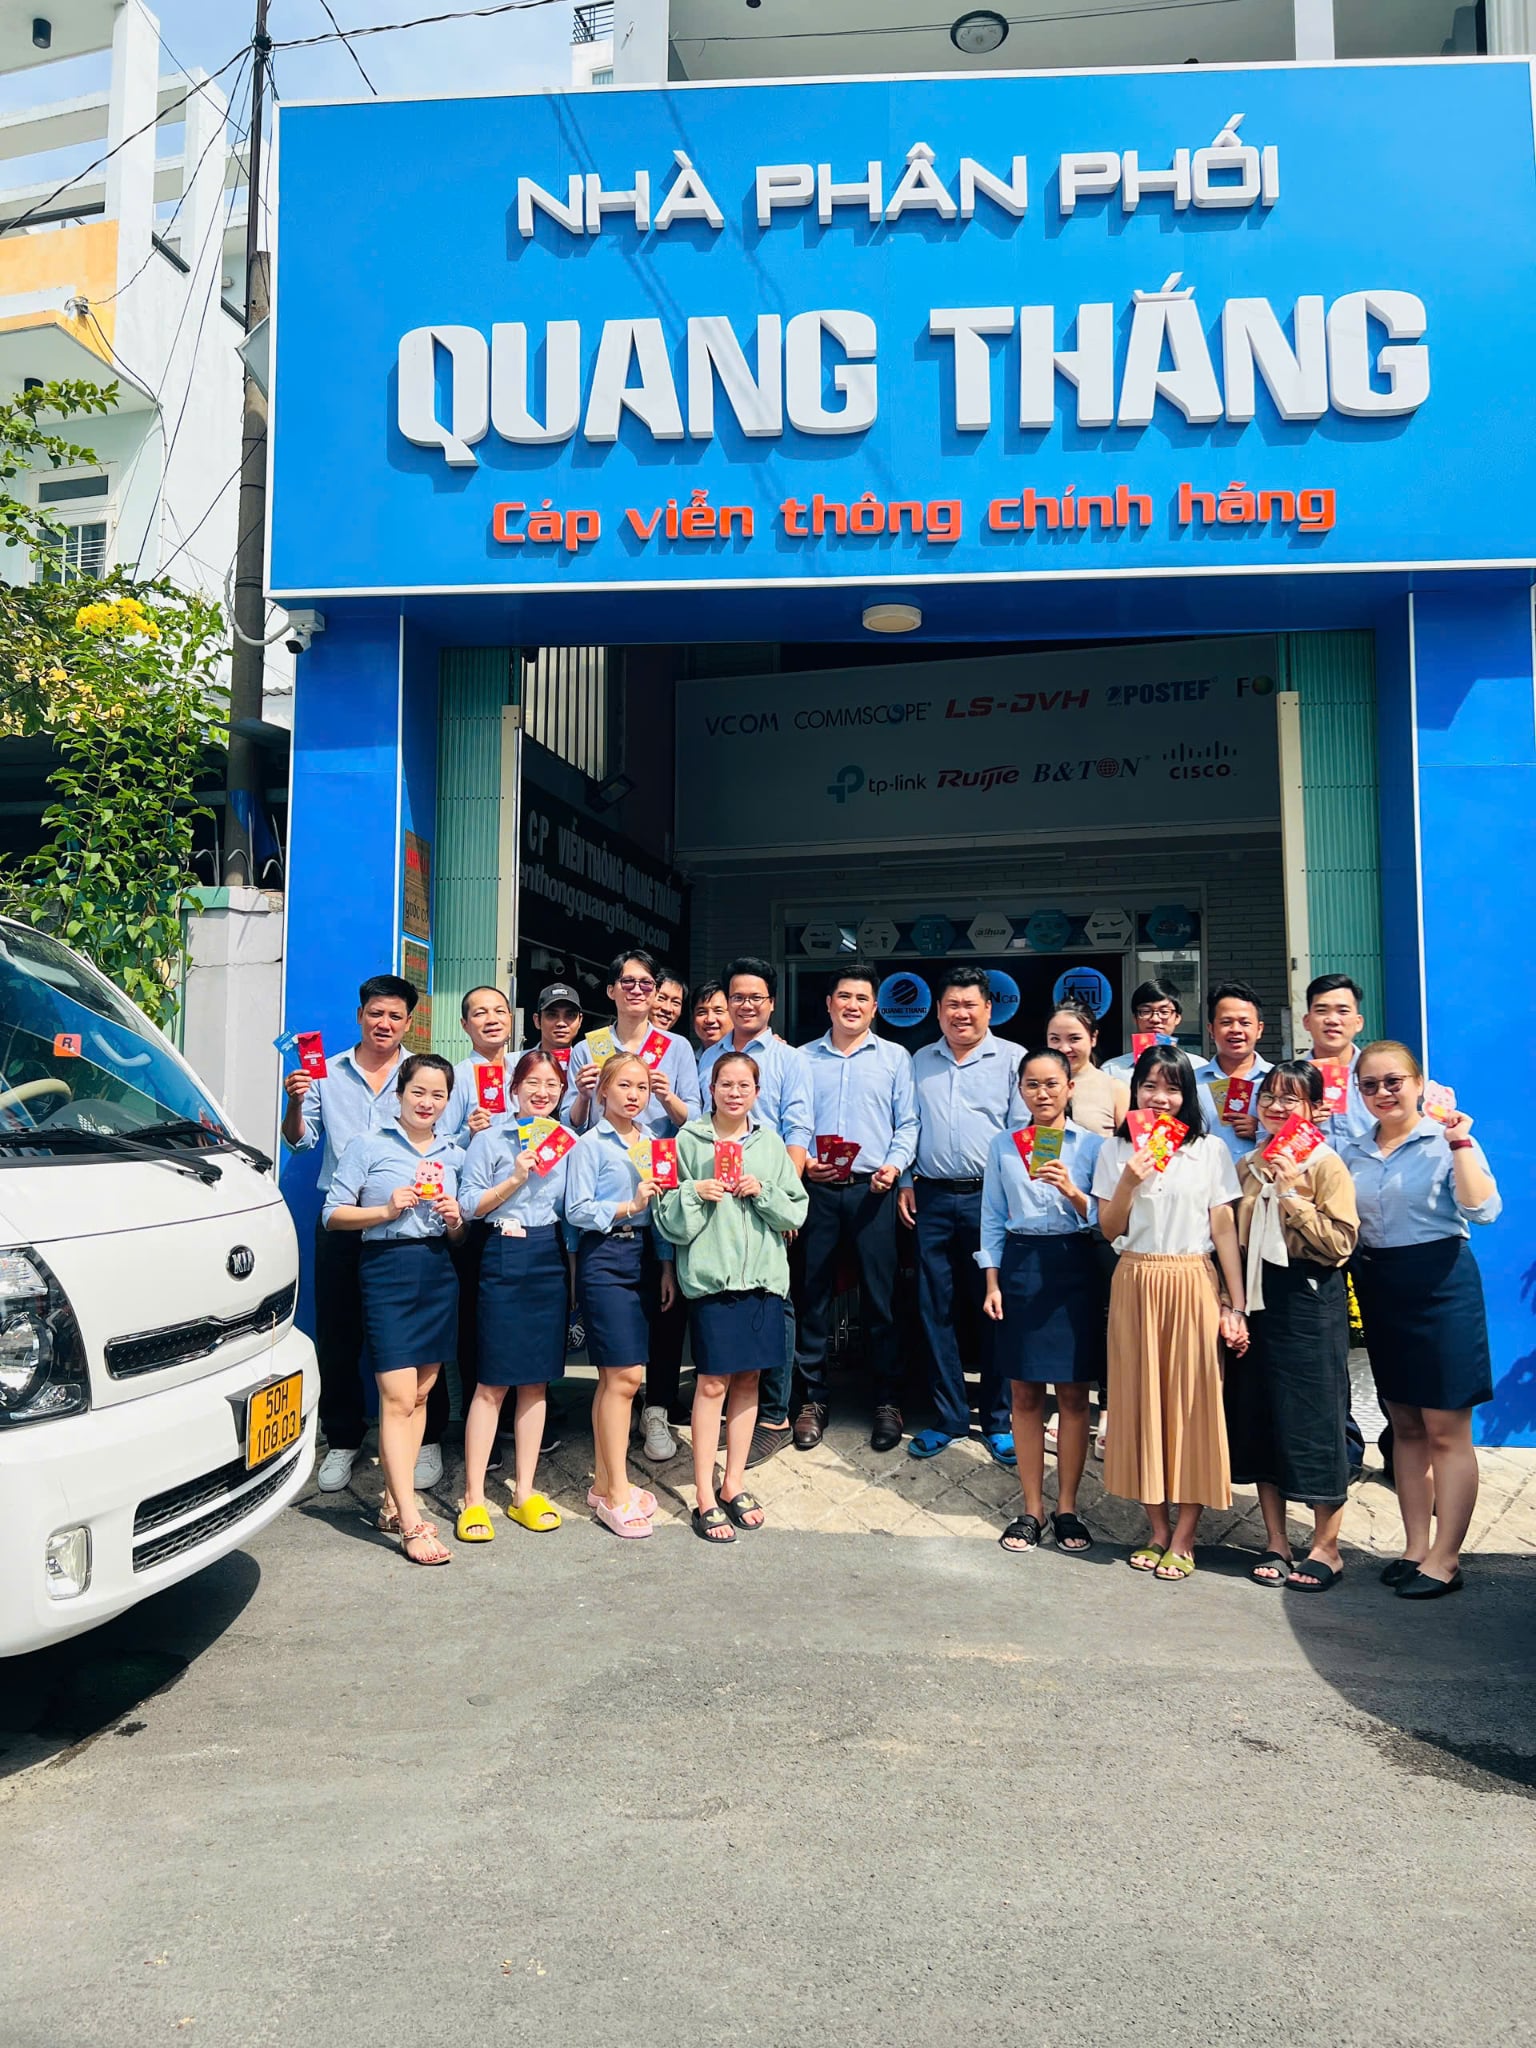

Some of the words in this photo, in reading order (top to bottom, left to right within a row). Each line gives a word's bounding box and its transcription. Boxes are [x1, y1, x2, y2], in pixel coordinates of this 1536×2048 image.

[518, 150, 724, 237] NHÀ
[755, 142, 1028, 226] PHÂN
[1059, 113, 1279, 215] PHỐI
[398, 309, 878, 467] QUANG
[930, 271, 1431, 428] THẮNG
[493, 498, 600, 551] Cáp
[625, 489, 754, 540] viễn
[780, 492, 962, 543] thông
[988, 484, 1153, 531] chính
[1178, 481, 1336, 533] hãng
[705, 713, 780, 736] VCOM
[794, 702, 928, 730] COMMSCOPE
[1124, 679, 1211, 705] POSTEF
[868, 773, 928, 796] tp-link
[937, 765, 1020, 793] Ruijie
[265, 1381, 289, 1420] 50H
[256, 1410, 296, 1458] 108.03
